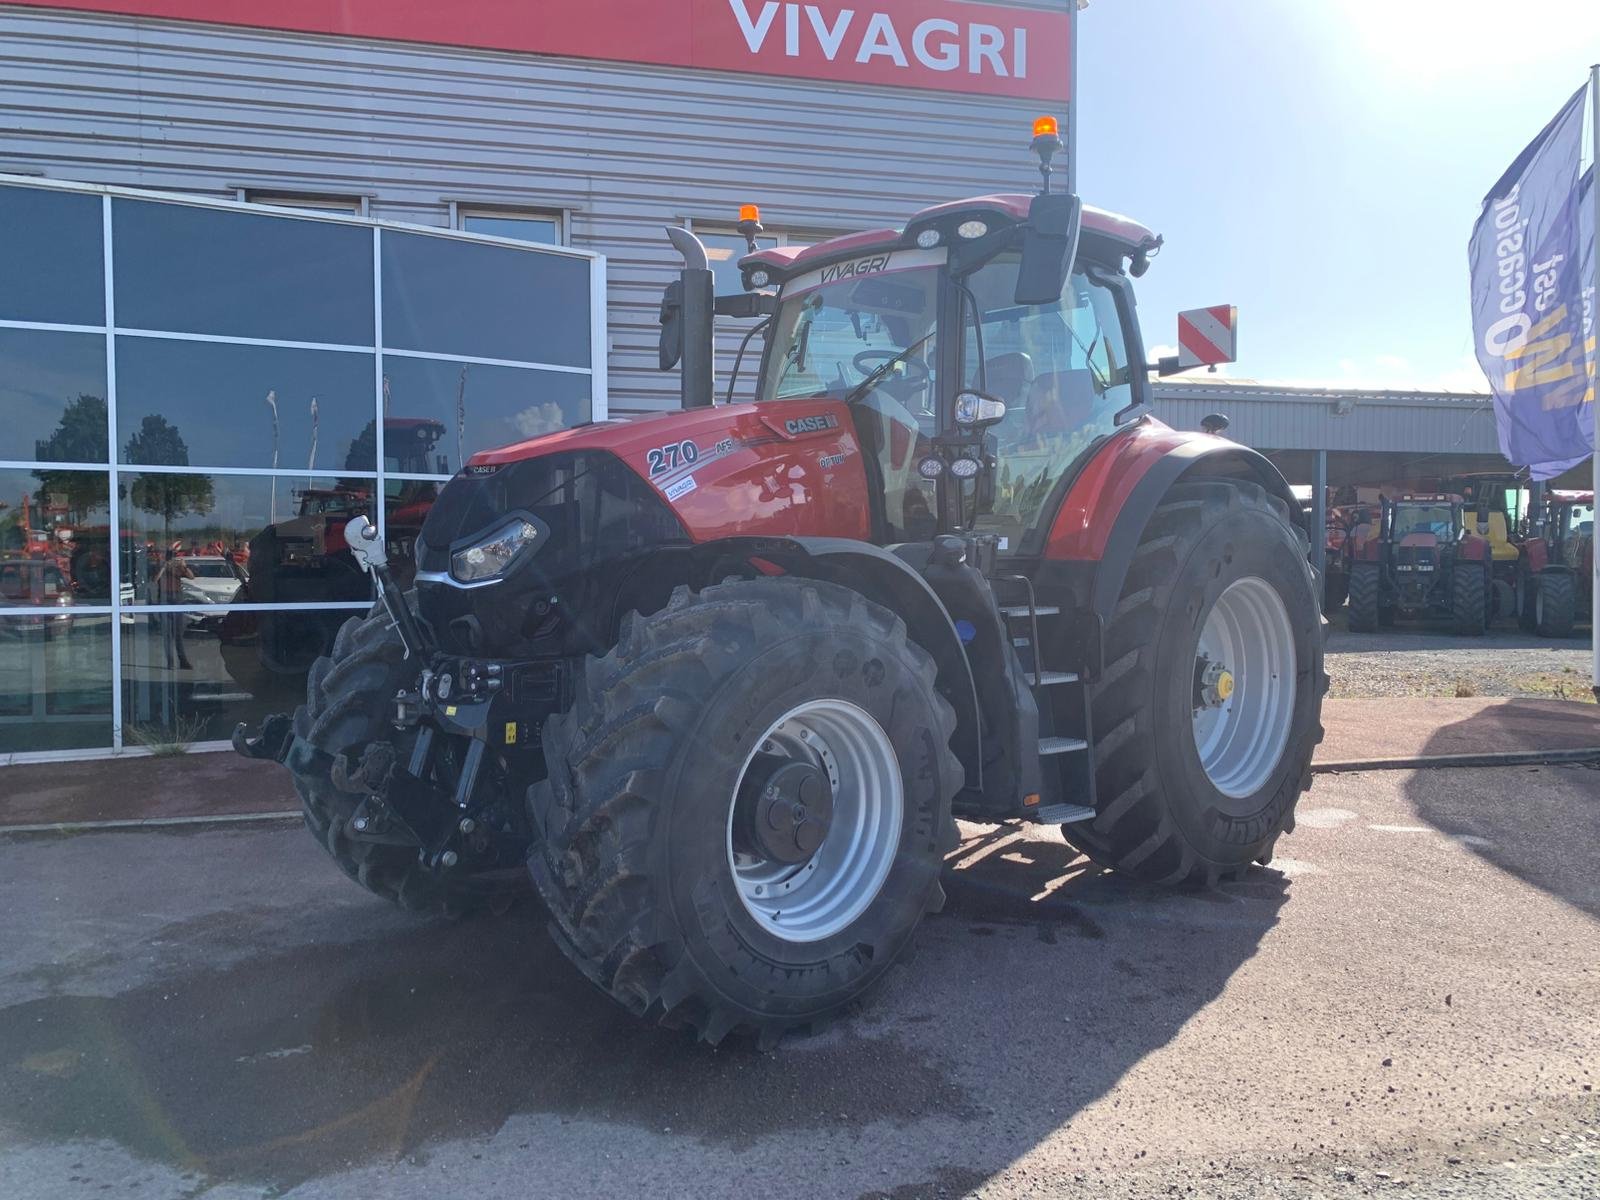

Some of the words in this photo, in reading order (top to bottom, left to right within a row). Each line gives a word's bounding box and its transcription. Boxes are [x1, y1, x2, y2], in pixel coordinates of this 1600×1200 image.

[729, 0, 1027, 78] VIVAGRI
[820, 252, 892, 284] VIVAGRI
[785, 415, 825, 434] CASE
[647, 440, 698, 475] 270
